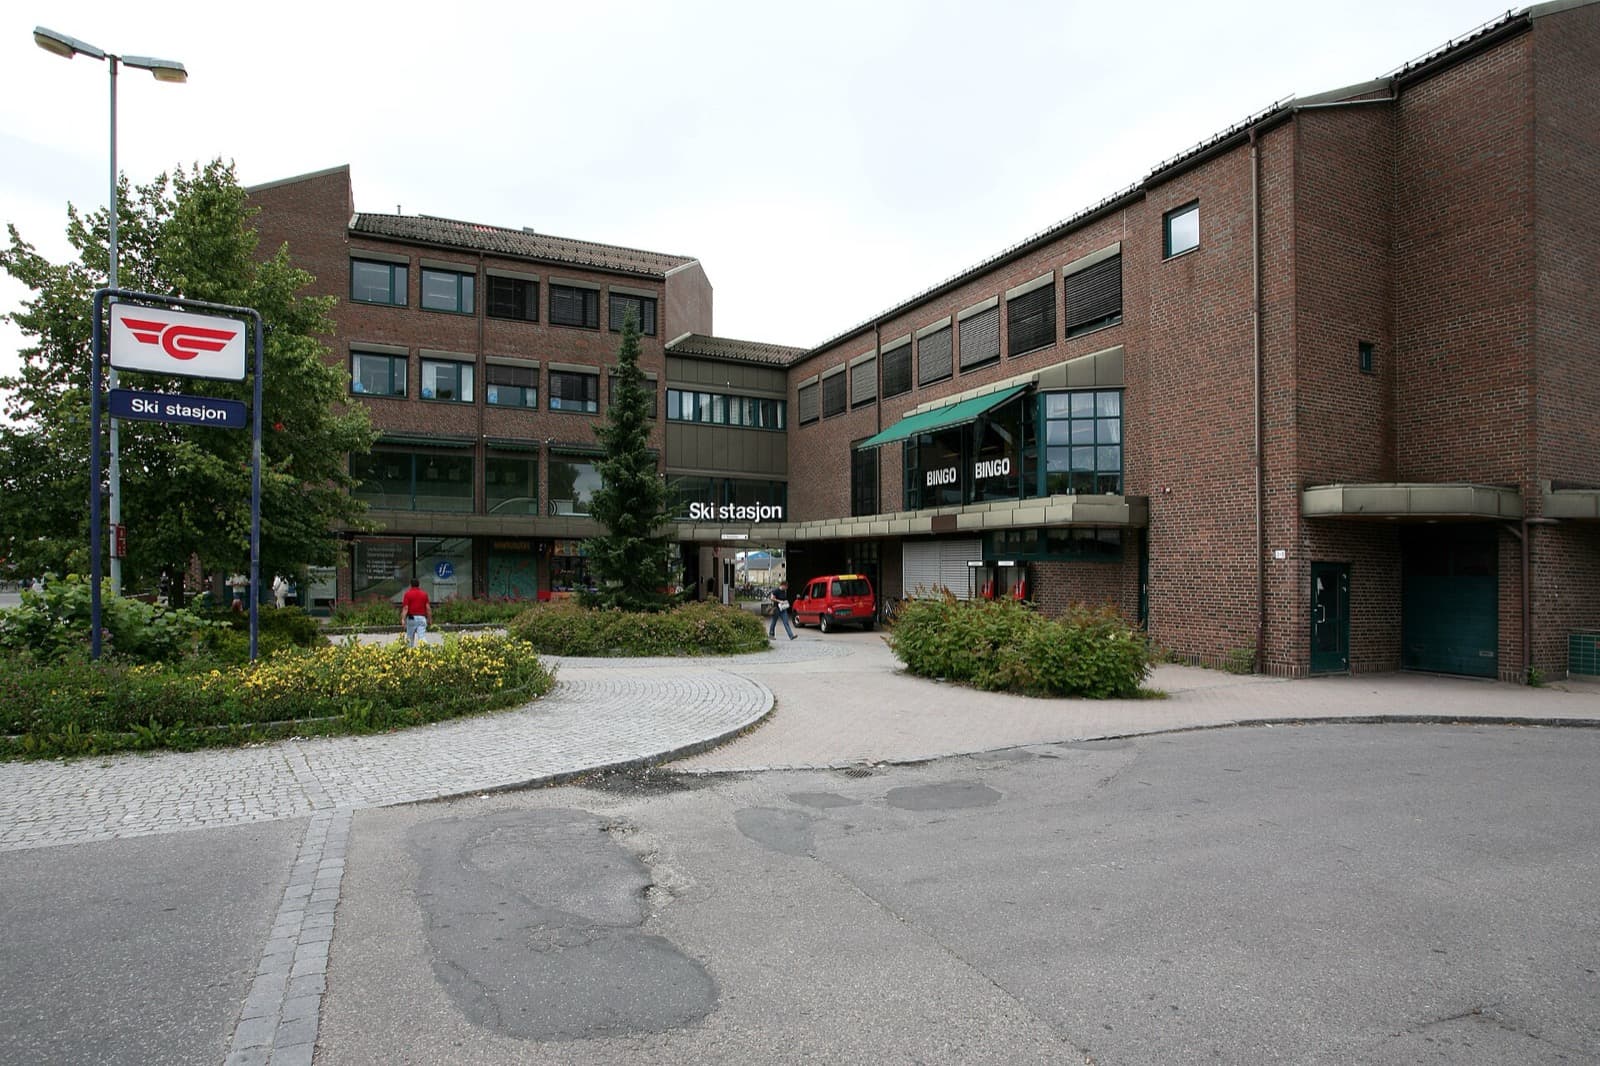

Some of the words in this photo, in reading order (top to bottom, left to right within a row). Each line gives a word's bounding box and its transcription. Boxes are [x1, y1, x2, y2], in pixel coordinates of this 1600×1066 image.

[131, 398, 159, 414] Ski
[166, 402, 227, 421] stasjon
[926, 467, 957, 487] BINGO
[975, 457, 1010, 479] BINGO
[689, 502, 714, 519] Ski
[719, 501, 782, 522] stasjon
